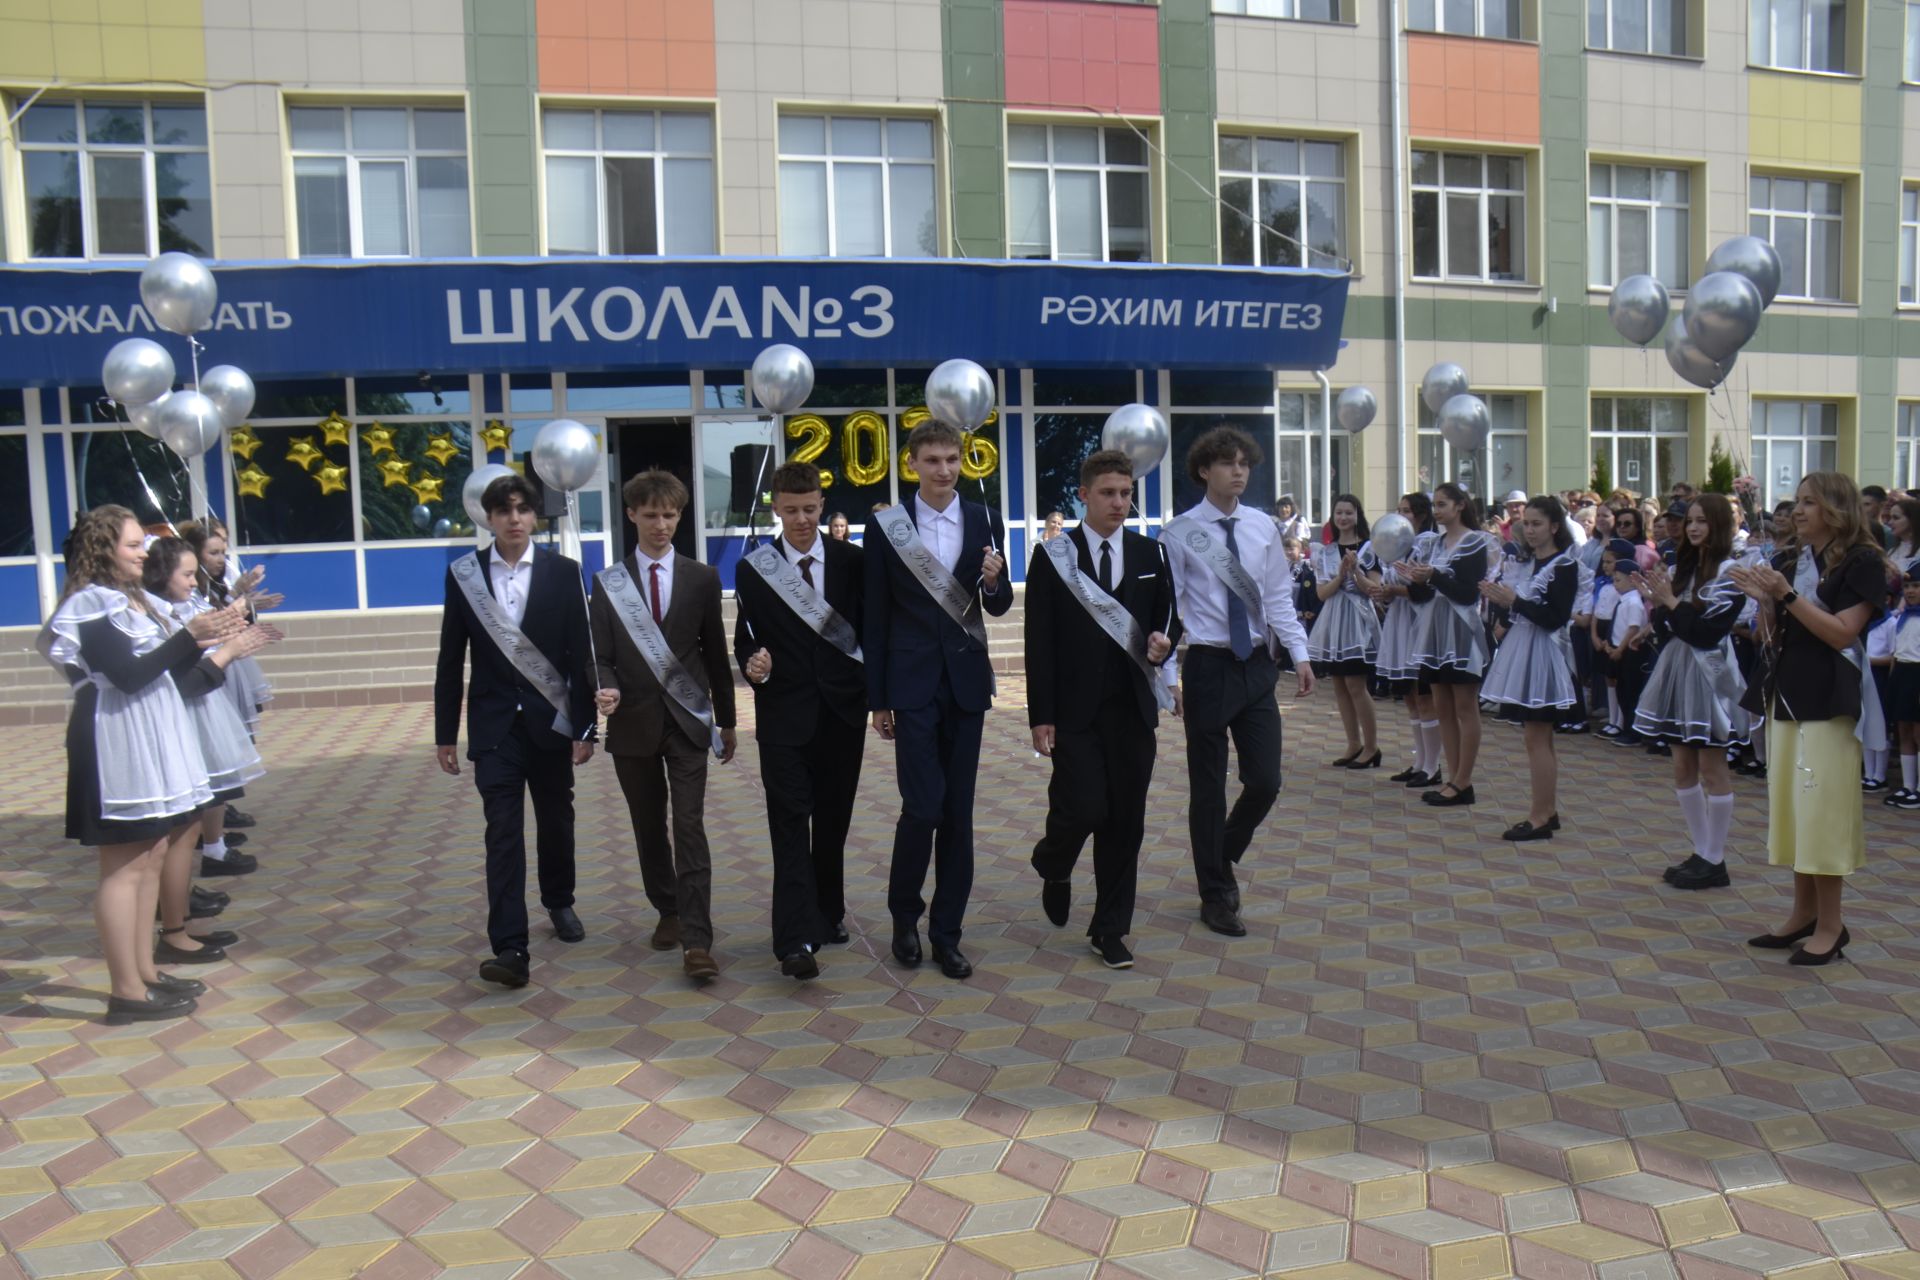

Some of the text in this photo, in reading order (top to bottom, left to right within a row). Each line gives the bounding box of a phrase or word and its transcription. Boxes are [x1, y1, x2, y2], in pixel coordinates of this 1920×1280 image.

[0, 301, 293, 335] ПОЖАЛАТЬ
[1040, 295, 1323, 330] РӘХИМ ИТЕГЕЗ
